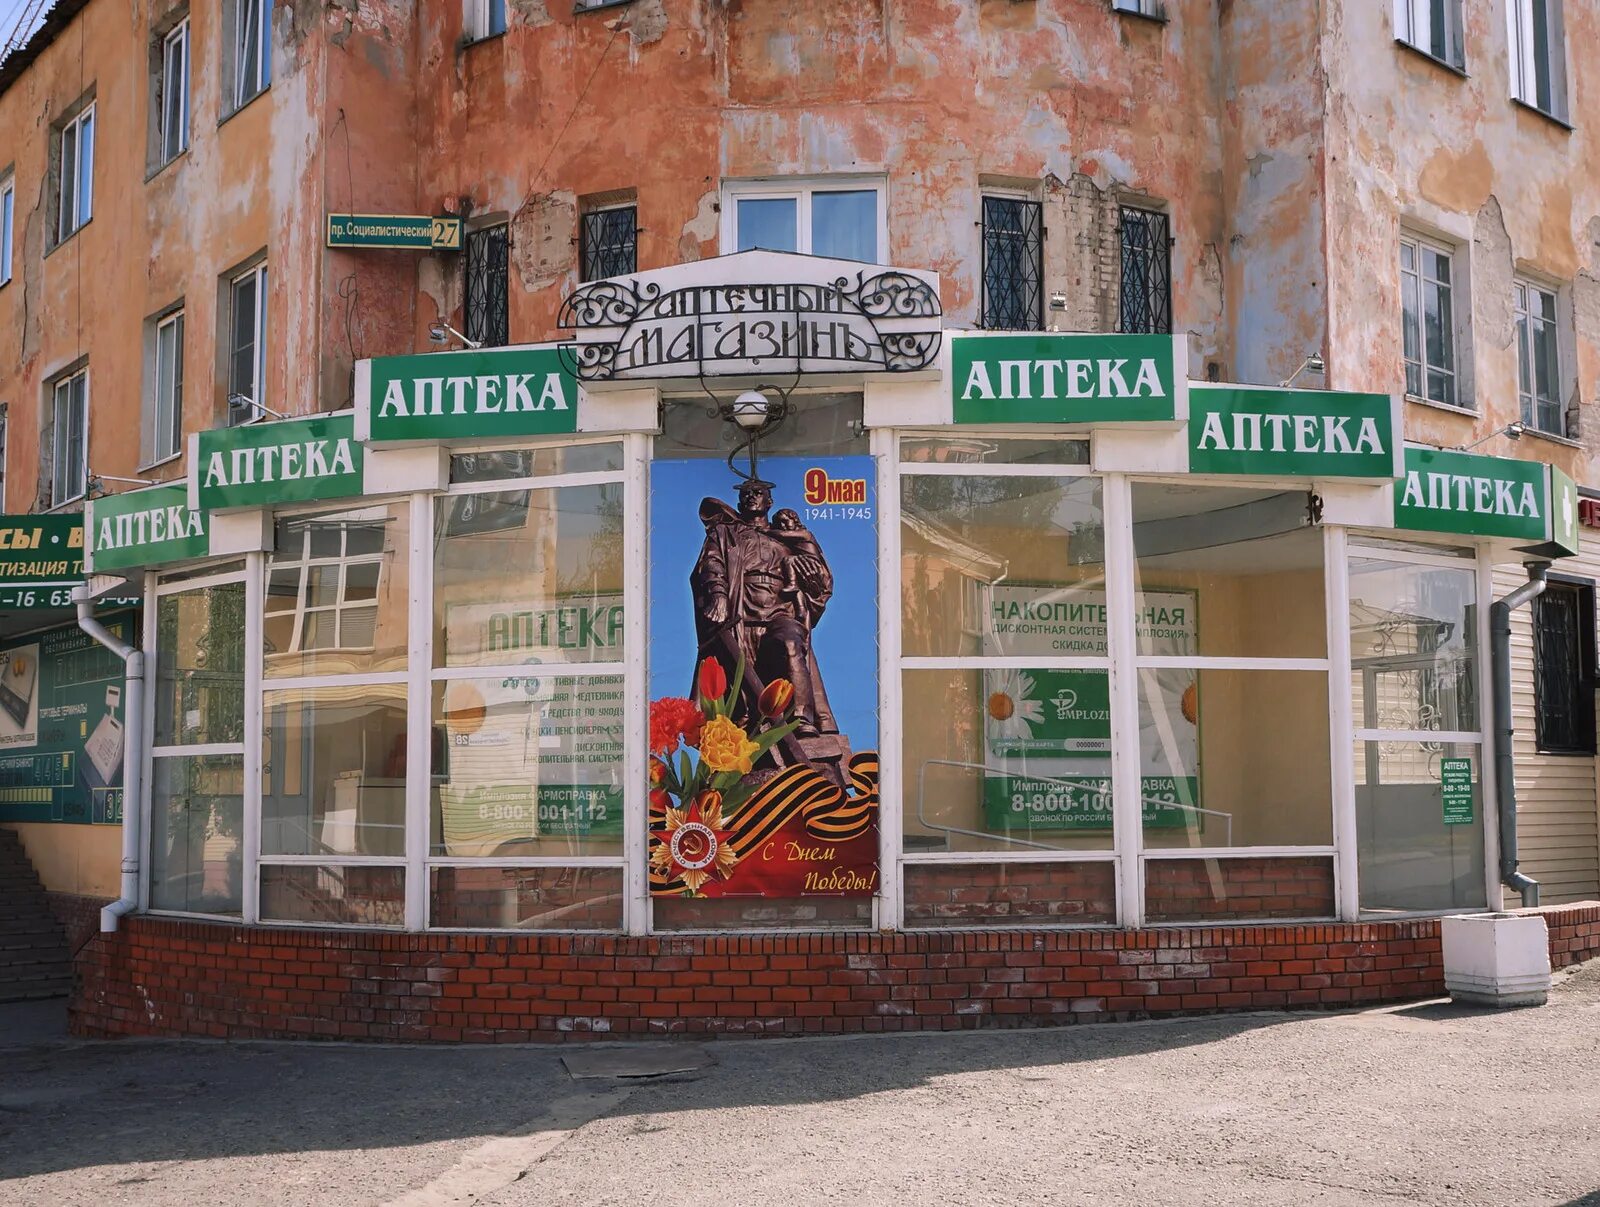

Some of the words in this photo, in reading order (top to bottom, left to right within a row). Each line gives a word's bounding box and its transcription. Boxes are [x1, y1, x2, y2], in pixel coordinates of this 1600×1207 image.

[331, 224, 344, 238] пр.
[347, 222, 432, 238] Социалистический
[434, 222, 458, 244] 27
[378, 373, 569, 418] АПТЕКА
[961, 358, 1166, 400] АПТЕКА
[1197, 412, 1386, 455] АПТЕКА
[203, 438, 356, 488] АПТЕКА
[1401, 470, 1541, 518] АПТЕКА
[97, 505, 204, 551] АПТЕКА
[805, 508, 872, 520] 1941-1945
[488, 604, 624, 651] АПТЕКА
[993, 624, 1066, 635] ДИСКОНТНАЯ
[1053, 640, 1093, 650] СКИДКА
[1444, 761, 1469, 770] АПТЕКА
[763, 842, 775, 861] С
[784, 840, 837, 861] Днем
[804, 865, 877, 890] Победы!
